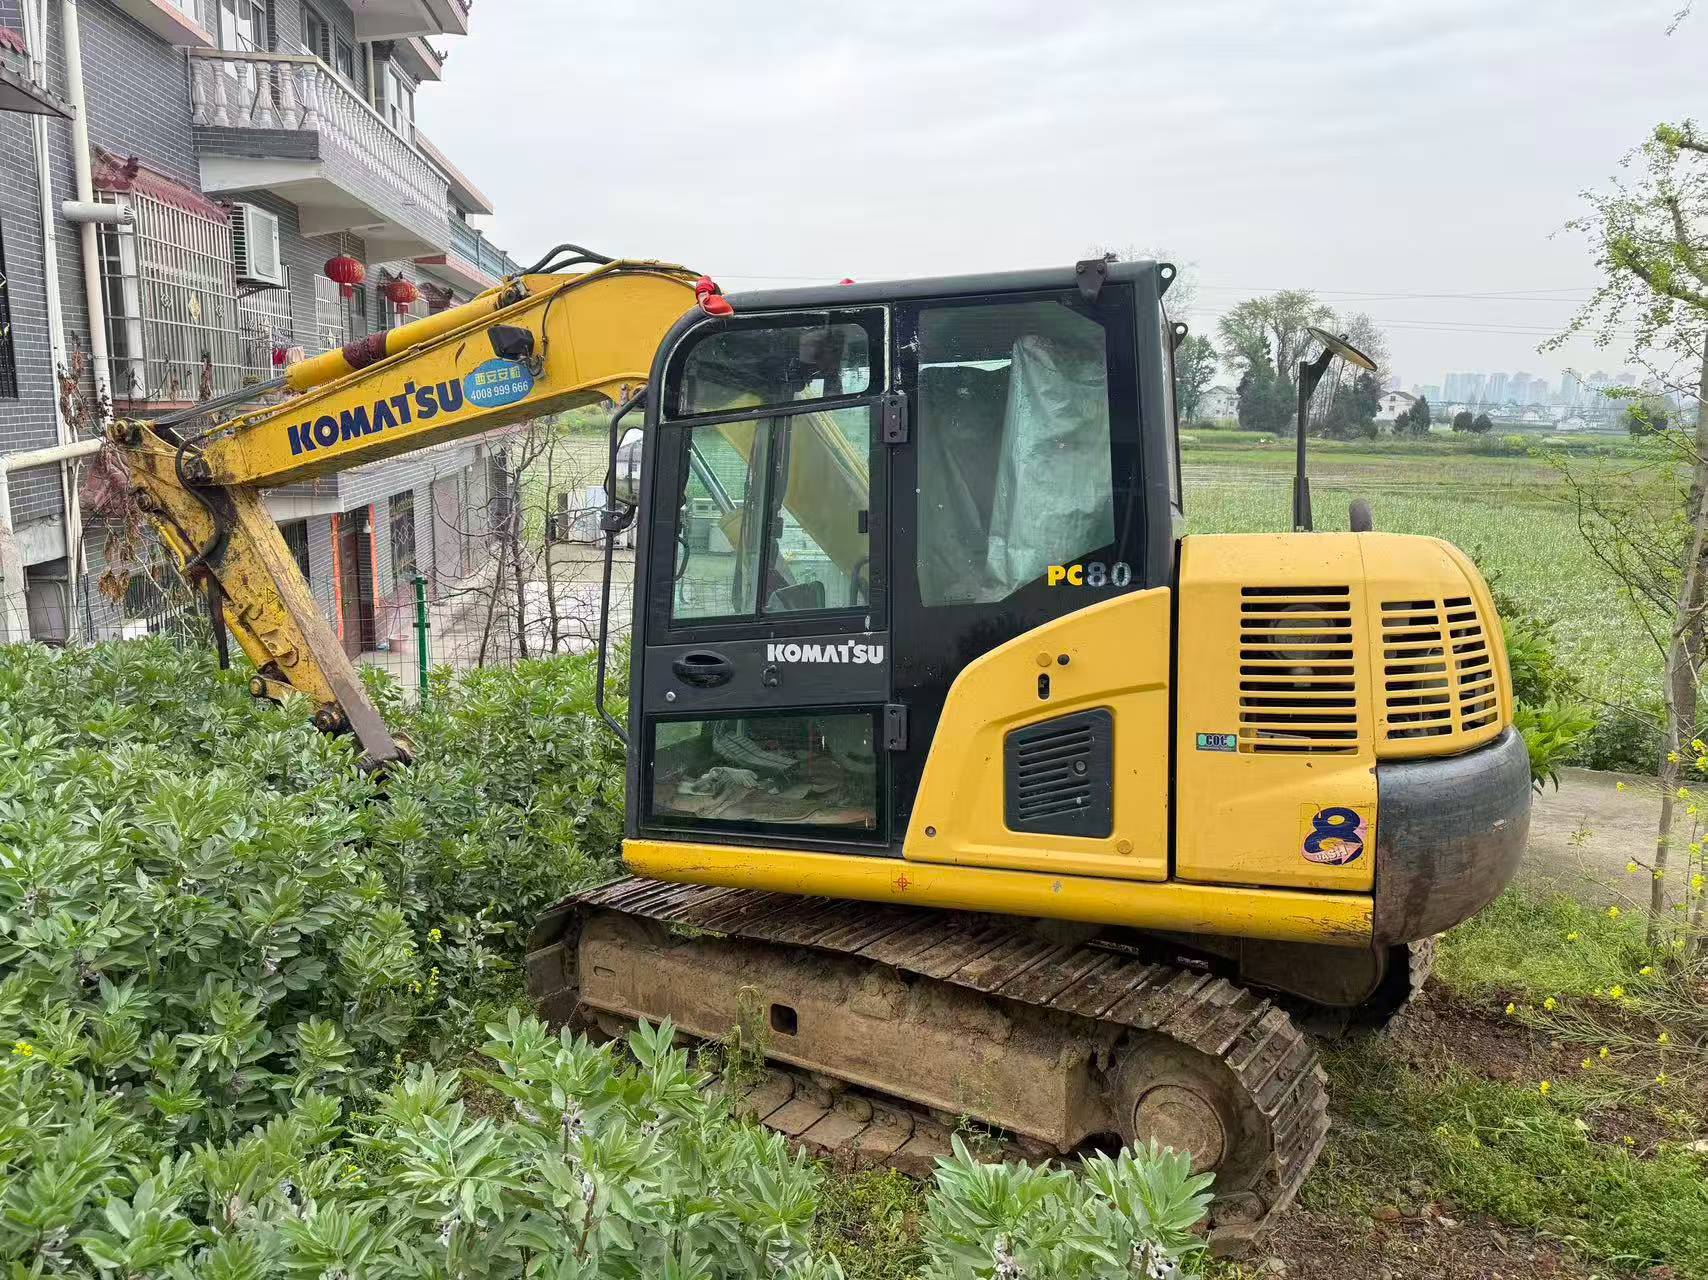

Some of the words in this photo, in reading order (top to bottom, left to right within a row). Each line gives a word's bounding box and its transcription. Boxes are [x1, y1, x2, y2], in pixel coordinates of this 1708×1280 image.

[471, 387, 493, 400] 4008
[494, 384, 510, 396] 999
[512, 381, 529, 393] 666
[287, 378, 464, 456] KOMATSU
[1047, 562, 1132, 587] PC80
[767, 640, 884, 664] KOMATSU
